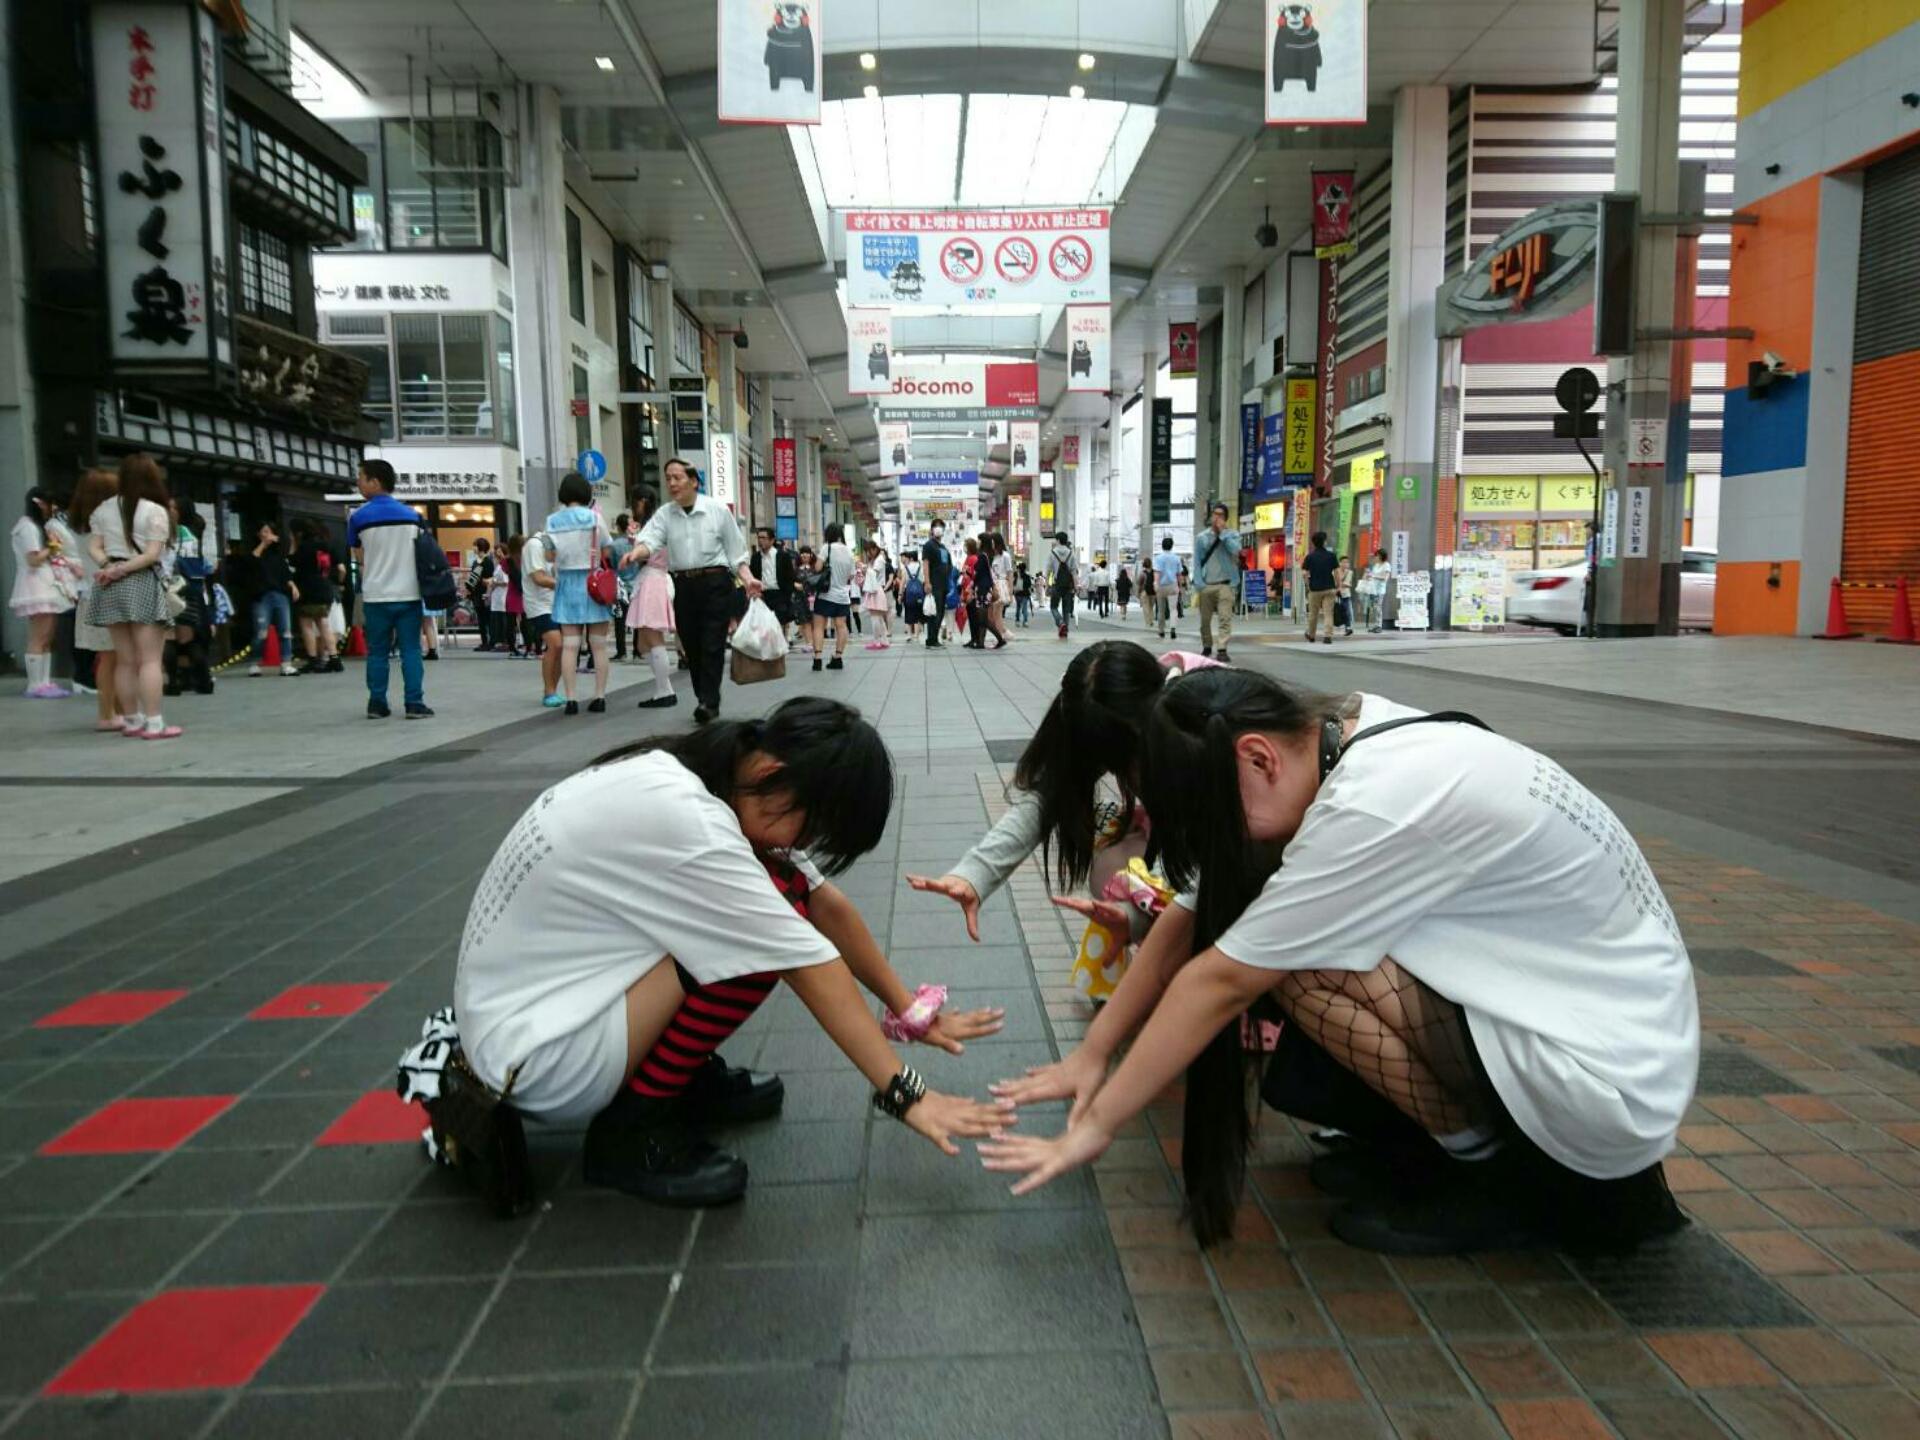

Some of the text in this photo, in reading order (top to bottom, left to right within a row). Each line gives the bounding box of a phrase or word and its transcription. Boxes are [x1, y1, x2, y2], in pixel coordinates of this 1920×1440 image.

[1051, 211, 1102, 227] 禁止区域
[420, 284, 450, 300] 文化
[892, 376, 973, 394] docomo
[1323, 334, 1335, 482] YONEZAWA
[1292, 406, 1309, 470] 処方せん
[714, 440, 727, 496] docomo
[1471, 486, 1531, 501] 処方せん
